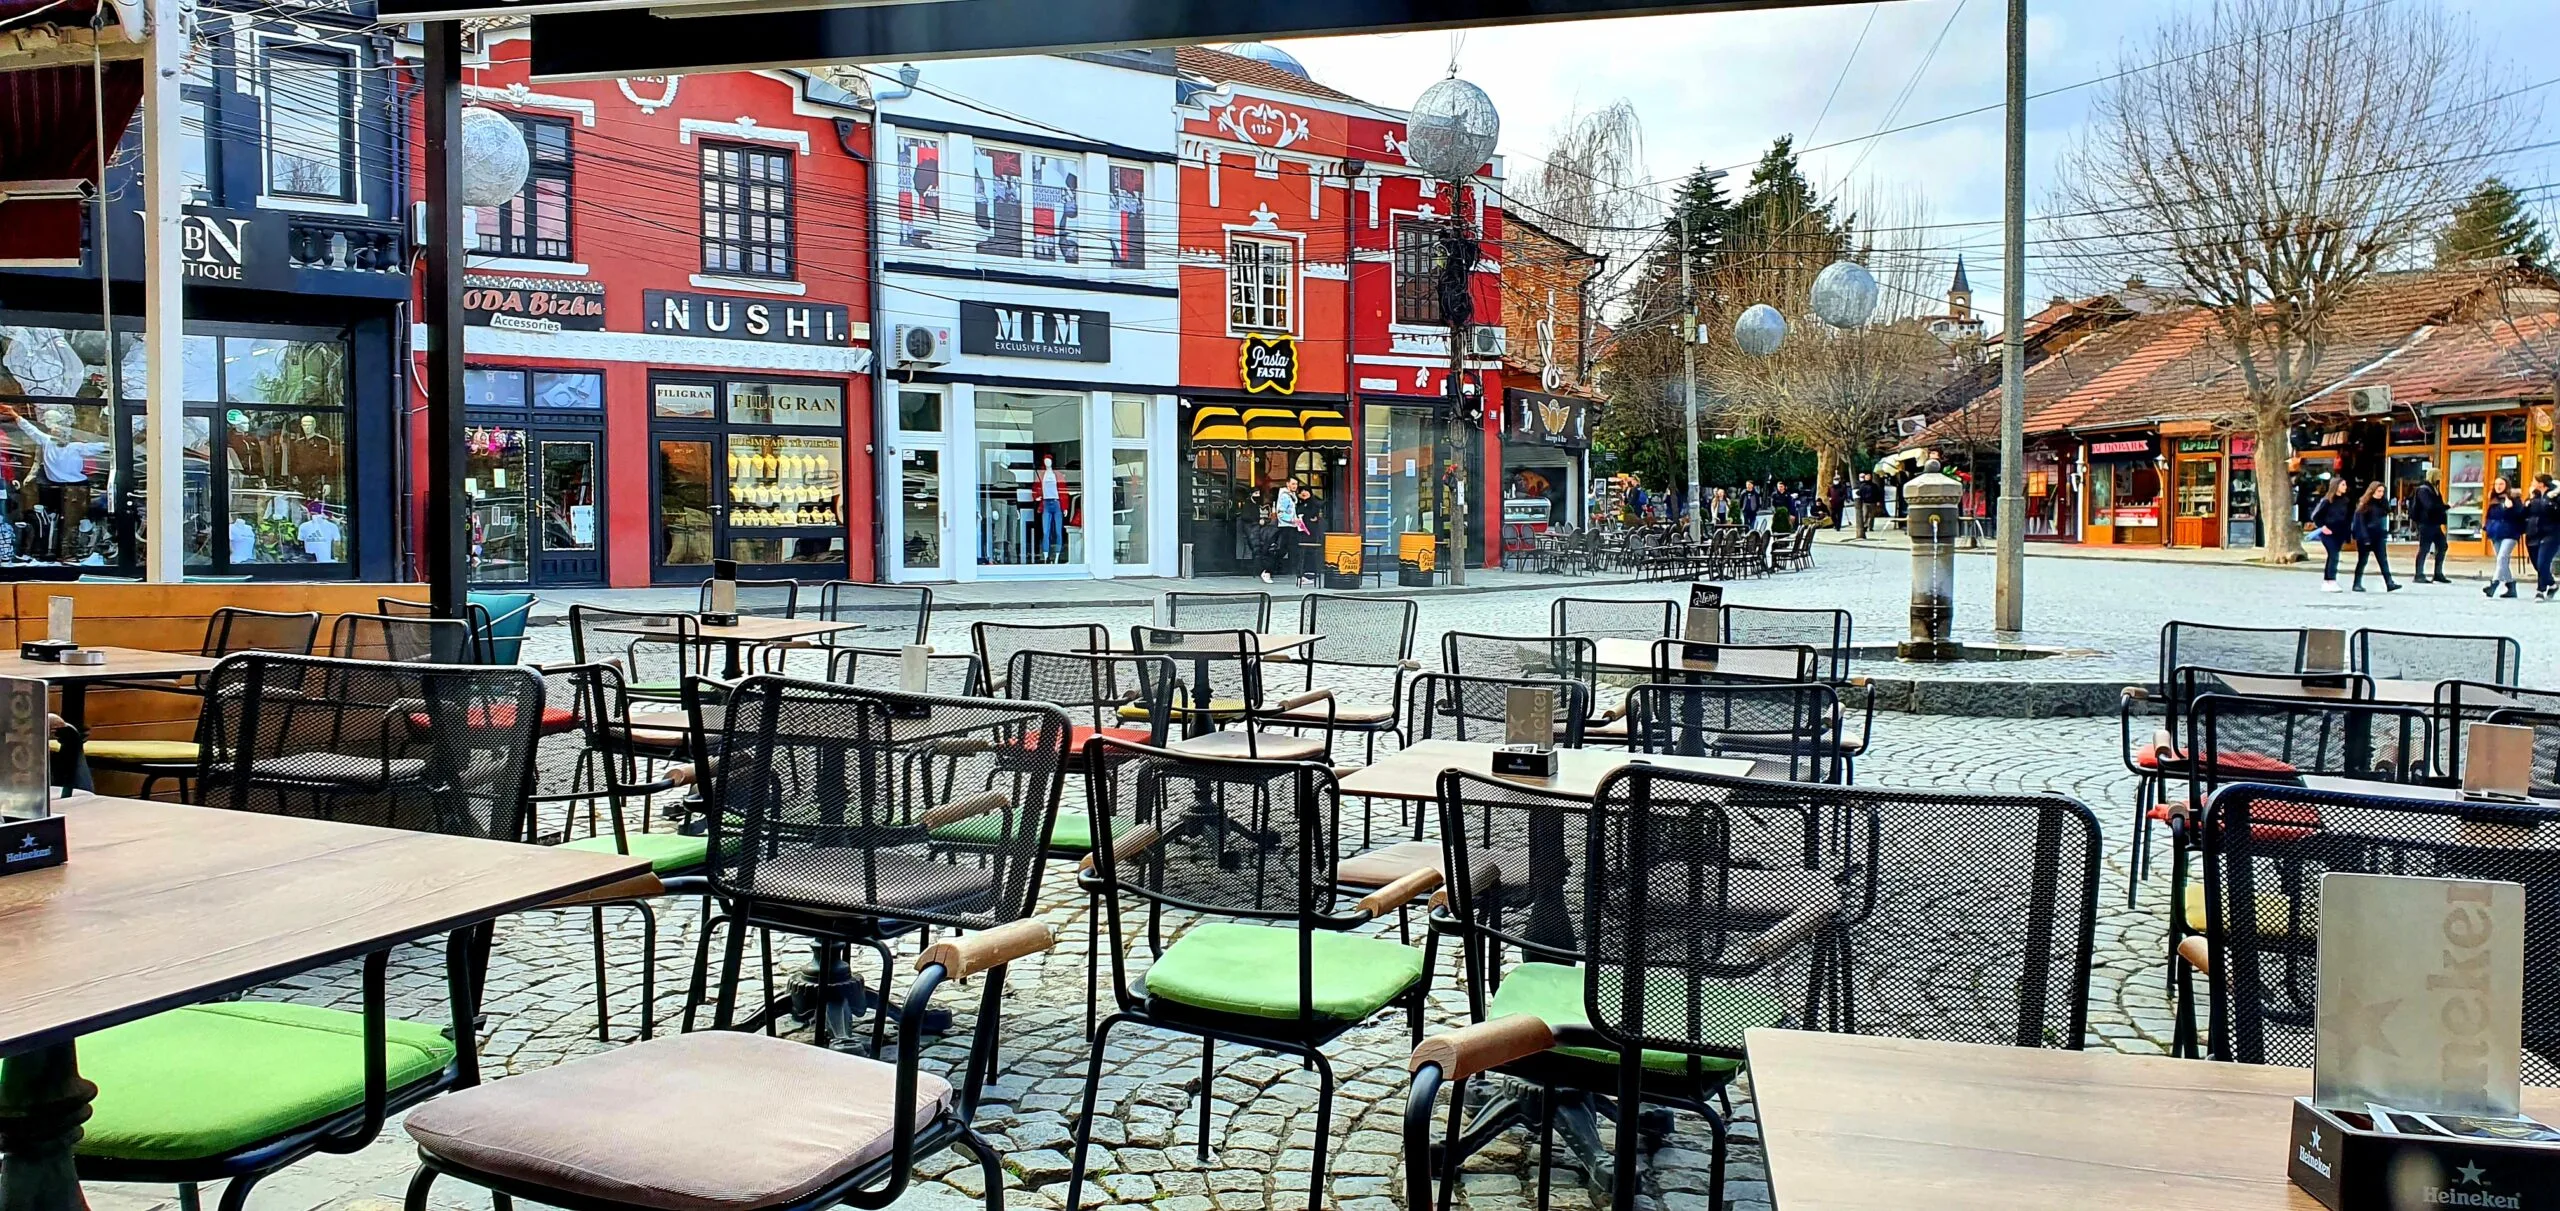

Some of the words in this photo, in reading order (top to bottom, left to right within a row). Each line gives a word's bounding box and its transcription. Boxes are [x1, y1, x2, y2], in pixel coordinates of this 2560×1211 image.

[528, 291, 603, 316] Bizhu
[494, 313, 560, 332] Accessories
[994, 308, 1081, 346] MIM
[995, 341, 1041, 353] EXCLUSIVE
[1042, 345, 1082, 355] FASHION
[1250, 345, 1290, 369] Pasta
[1256, 367, 1286, 379] FASTA
[657, 389, 712, 399] FILIGRAN
[733, 394, 837, 412] FILIGRAN
[2299, 1144, 2332, 1180] Heineken
[2423, 1185, 2522, 1211] Heineken
